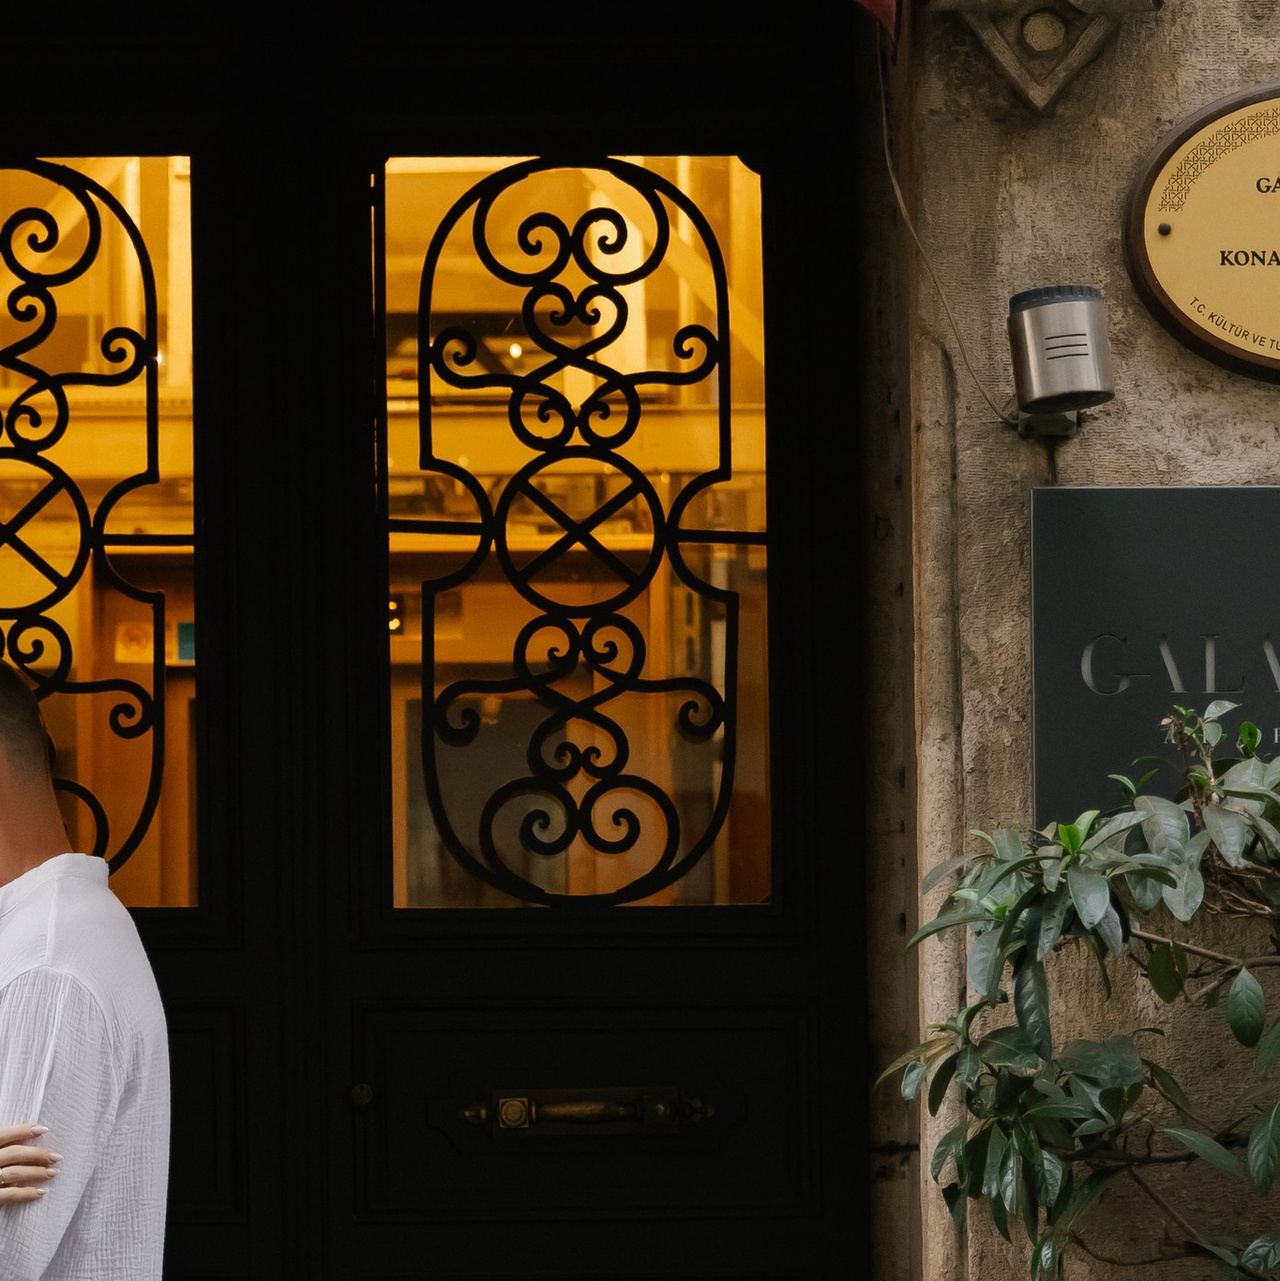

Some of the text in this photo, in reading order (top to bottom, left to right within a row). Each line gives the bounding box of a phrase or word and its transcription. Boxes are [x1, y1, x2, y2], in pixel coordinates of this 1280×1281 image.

[1219, 250, 1280, 266] KONA
[1189, 296, 1206, 316] T.C.
[1207, 312, 1250, 340] KÜLTÜR
[1252, 333, 1267, 347] VE
